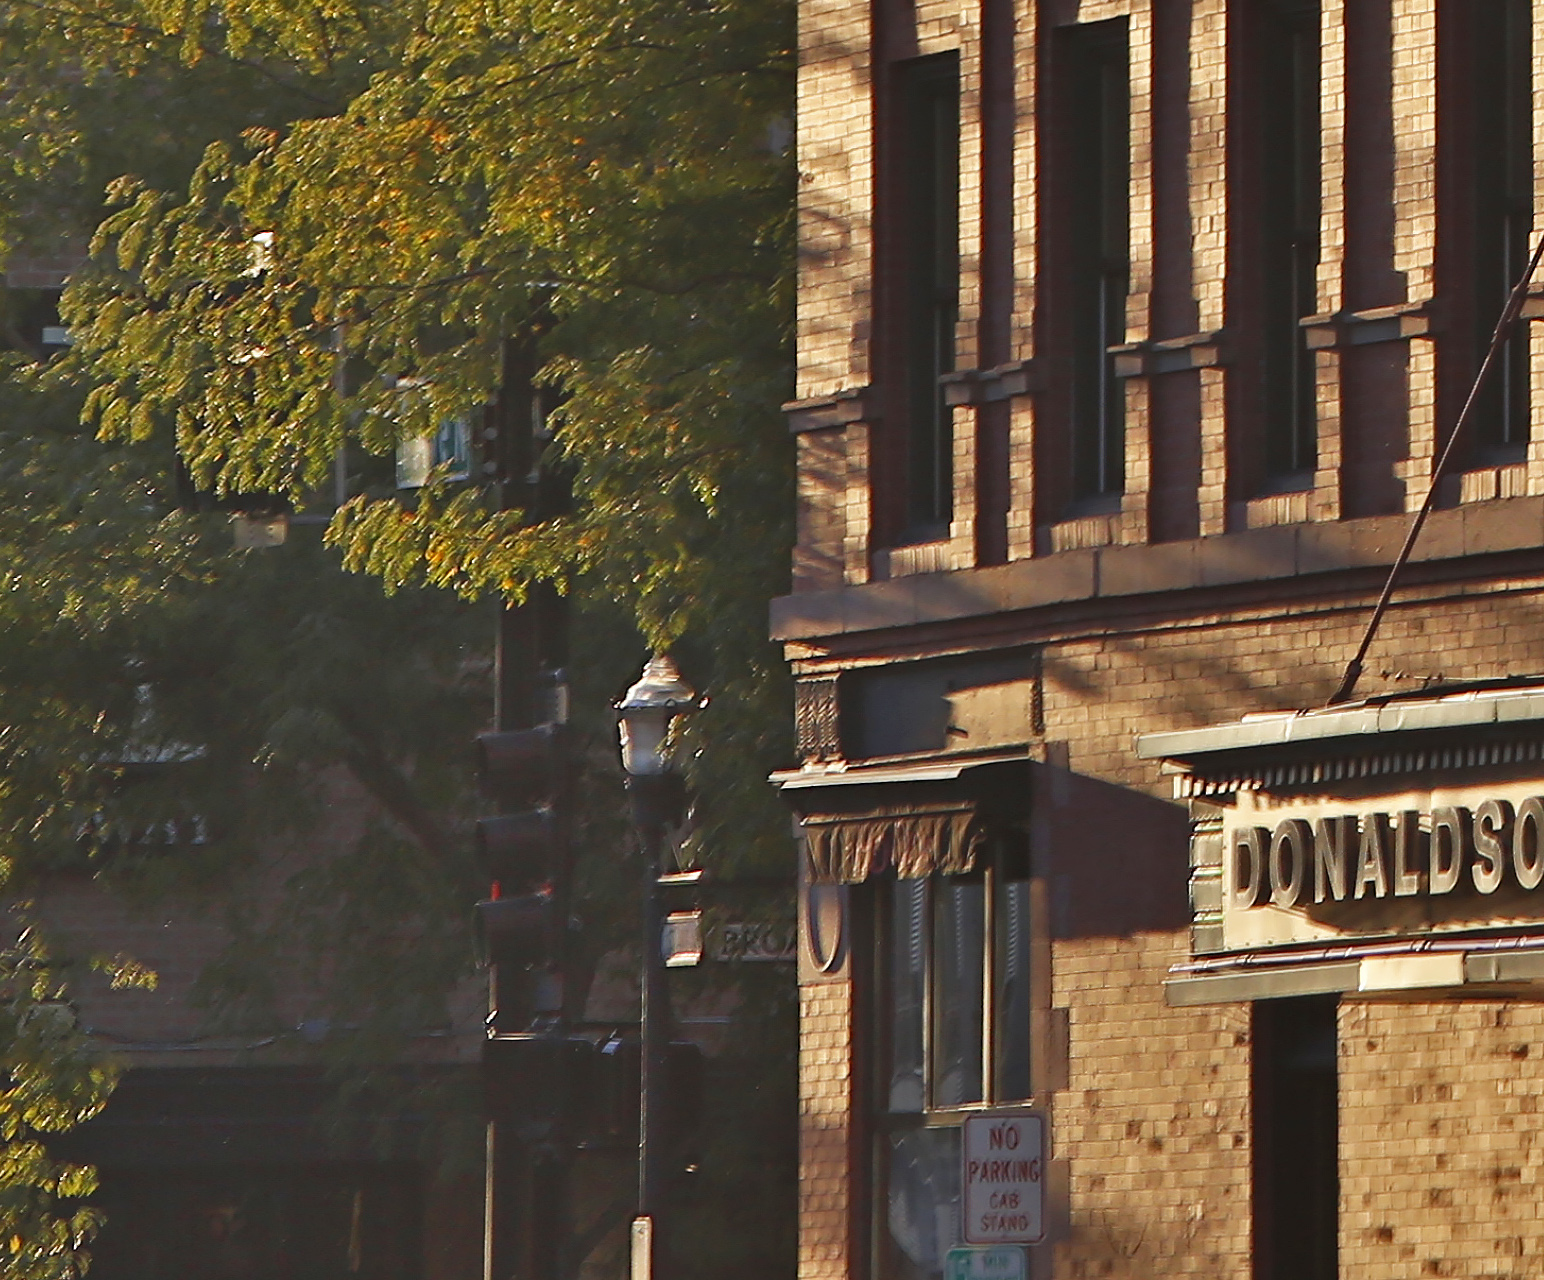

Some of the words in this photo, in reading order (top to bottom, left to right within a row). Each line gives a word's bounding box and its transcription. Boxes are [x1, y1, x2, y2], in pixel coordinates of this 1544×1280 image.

[989, 1126, 1018, 1151] NO
[968, 1159, 1040, 1184] PARKING
[989, 1192, 1019, 1210] CAB
[980, 1214, 1028, 1233] STAND
